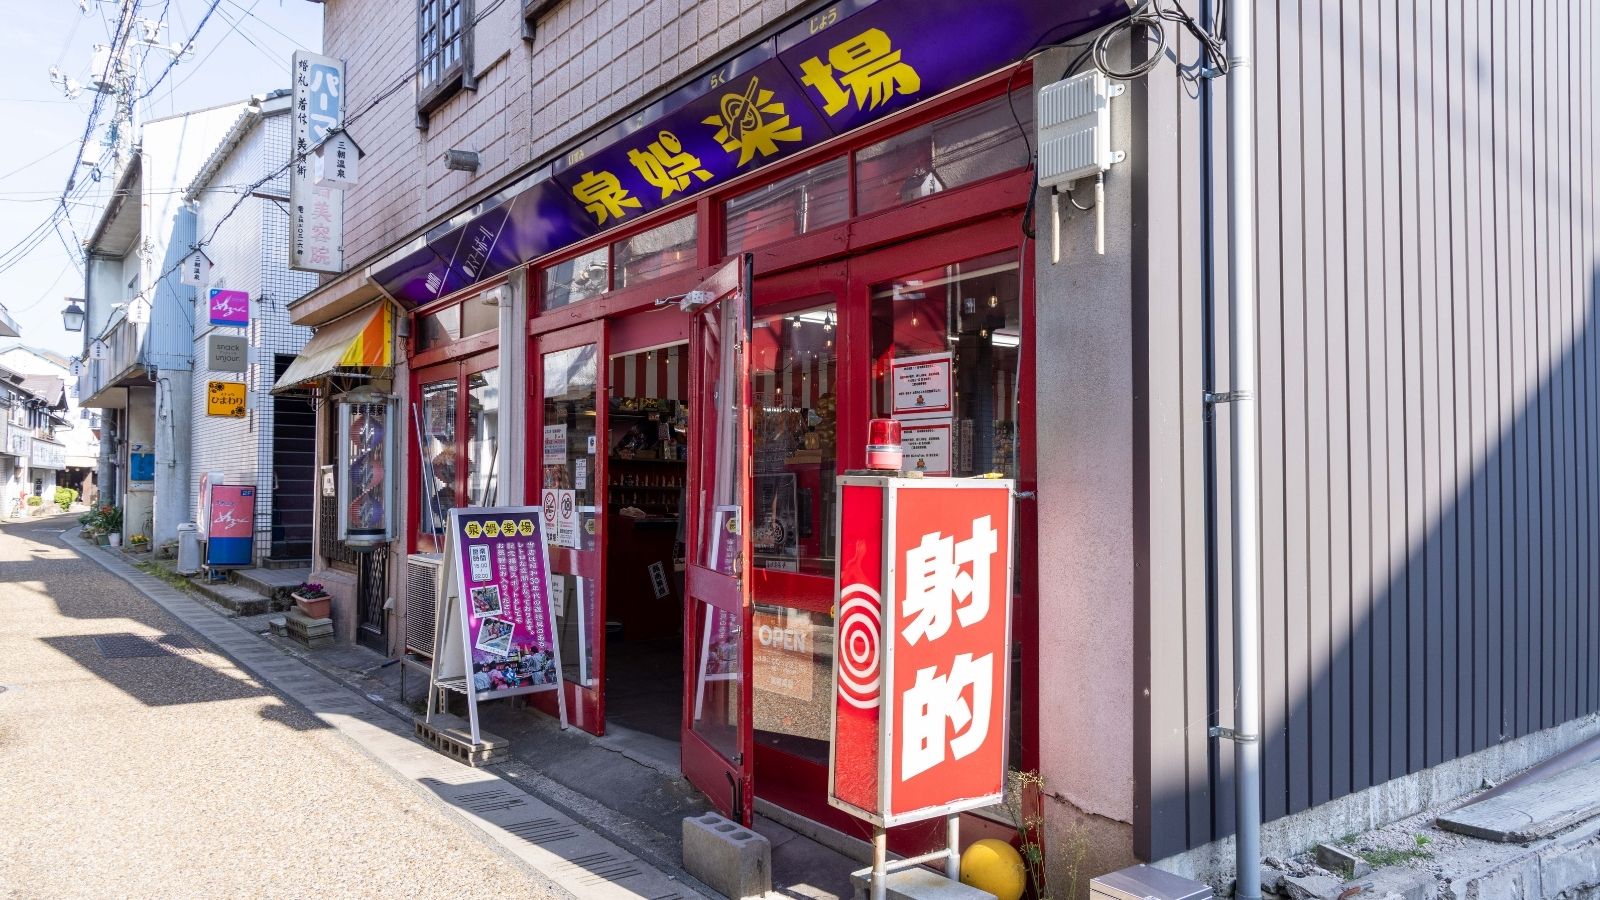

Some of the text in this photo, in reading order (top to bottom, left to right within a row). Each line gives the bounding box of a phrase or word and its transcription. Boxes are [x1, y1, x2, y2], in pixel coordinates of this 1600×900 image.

[809, 8, 837, 34] じょう
[710, 68, 726, 89] らく
[310, 70, 339, 138] パーマ
[336, 141, 346, 179] 三朝温泉
[211, 396, 243, 405] ひまわり
[468, 521, 532, 536] 泉娯楽場
[758, 624, 806, 653] OPEN
[901, 514, 998, 783] 射的
